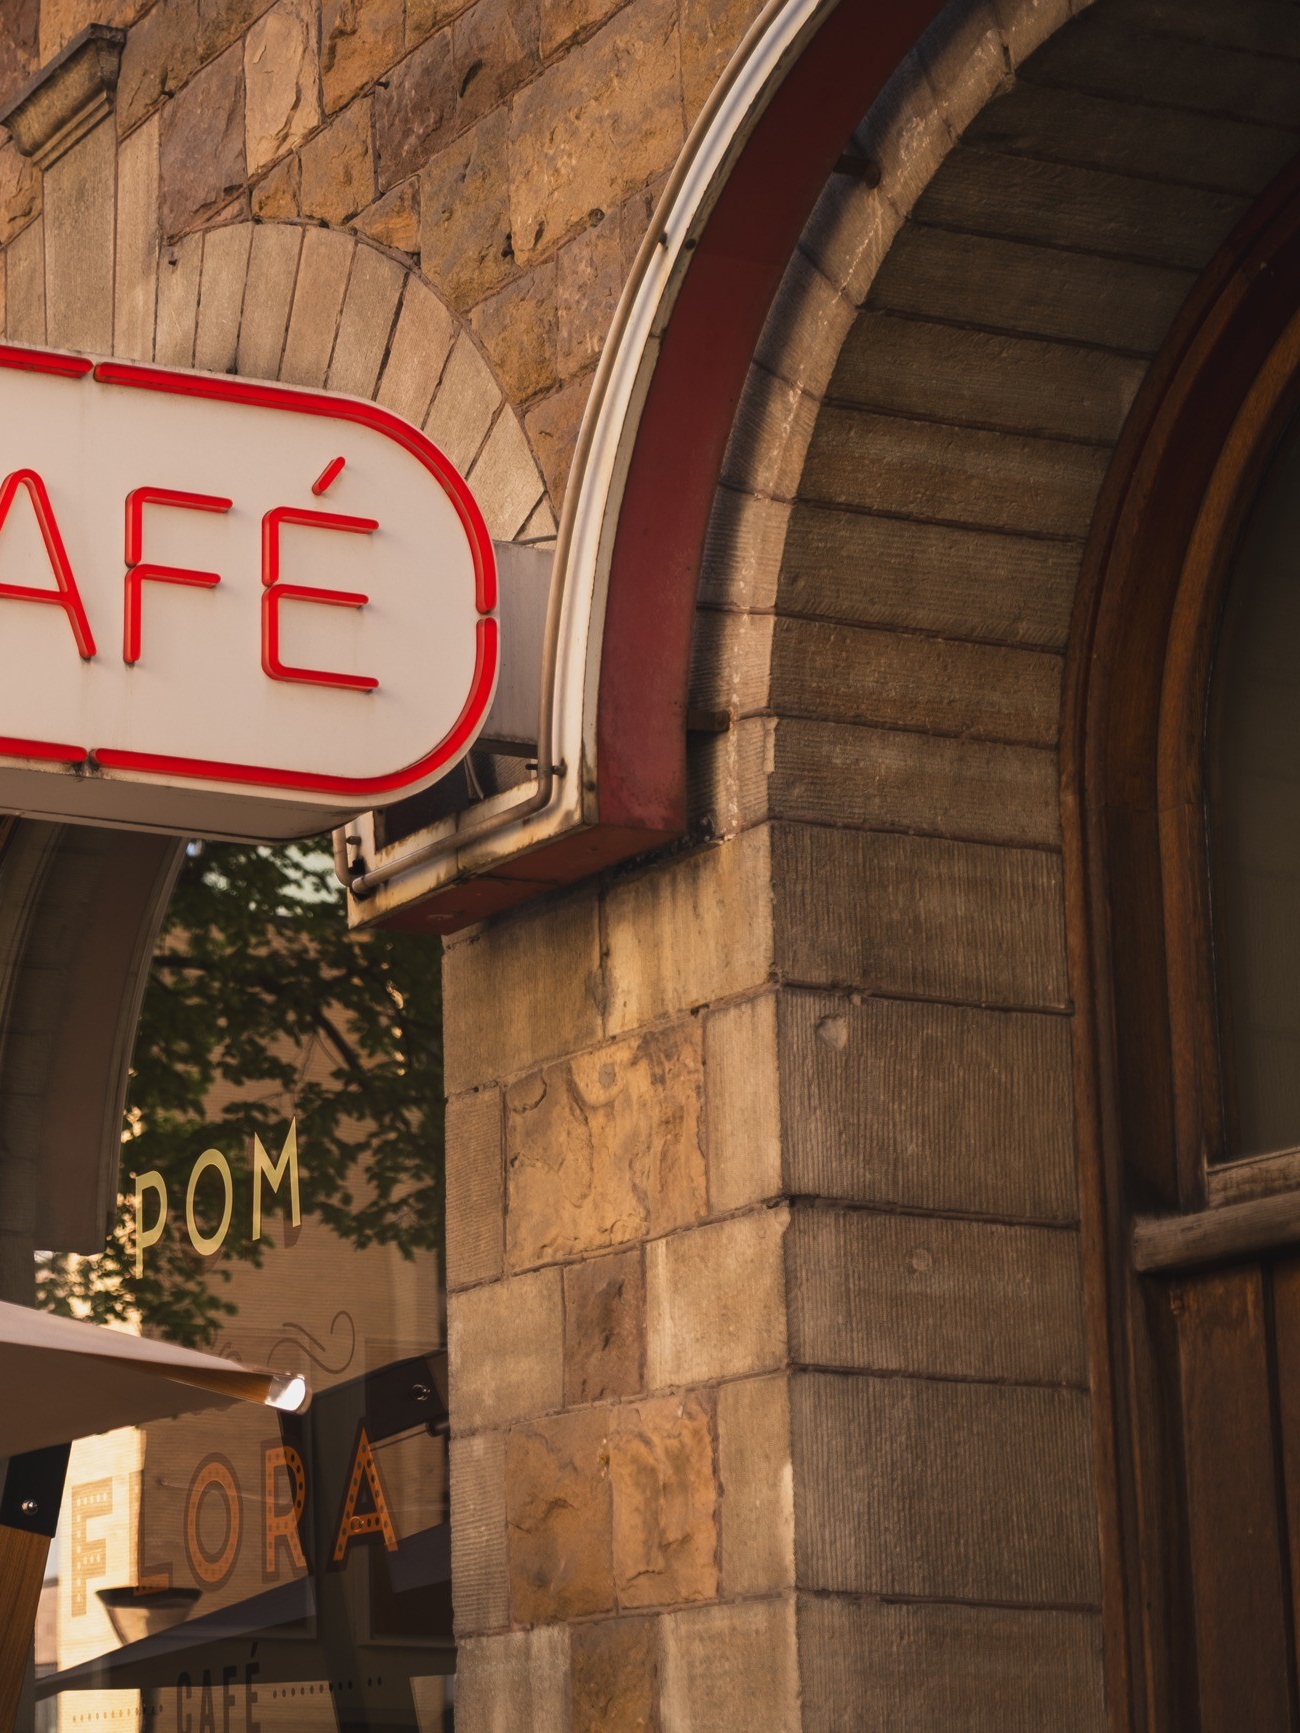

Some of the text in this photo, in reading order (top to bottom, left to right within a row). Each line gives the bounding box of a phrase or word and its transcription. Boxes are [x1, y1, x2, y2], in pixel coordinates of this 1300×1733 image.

[134, 1117, 302, 1280] POM
[70, 1416, 402, 1618] FLORA
[176, 1641, 260, 1733] CAFÉ
